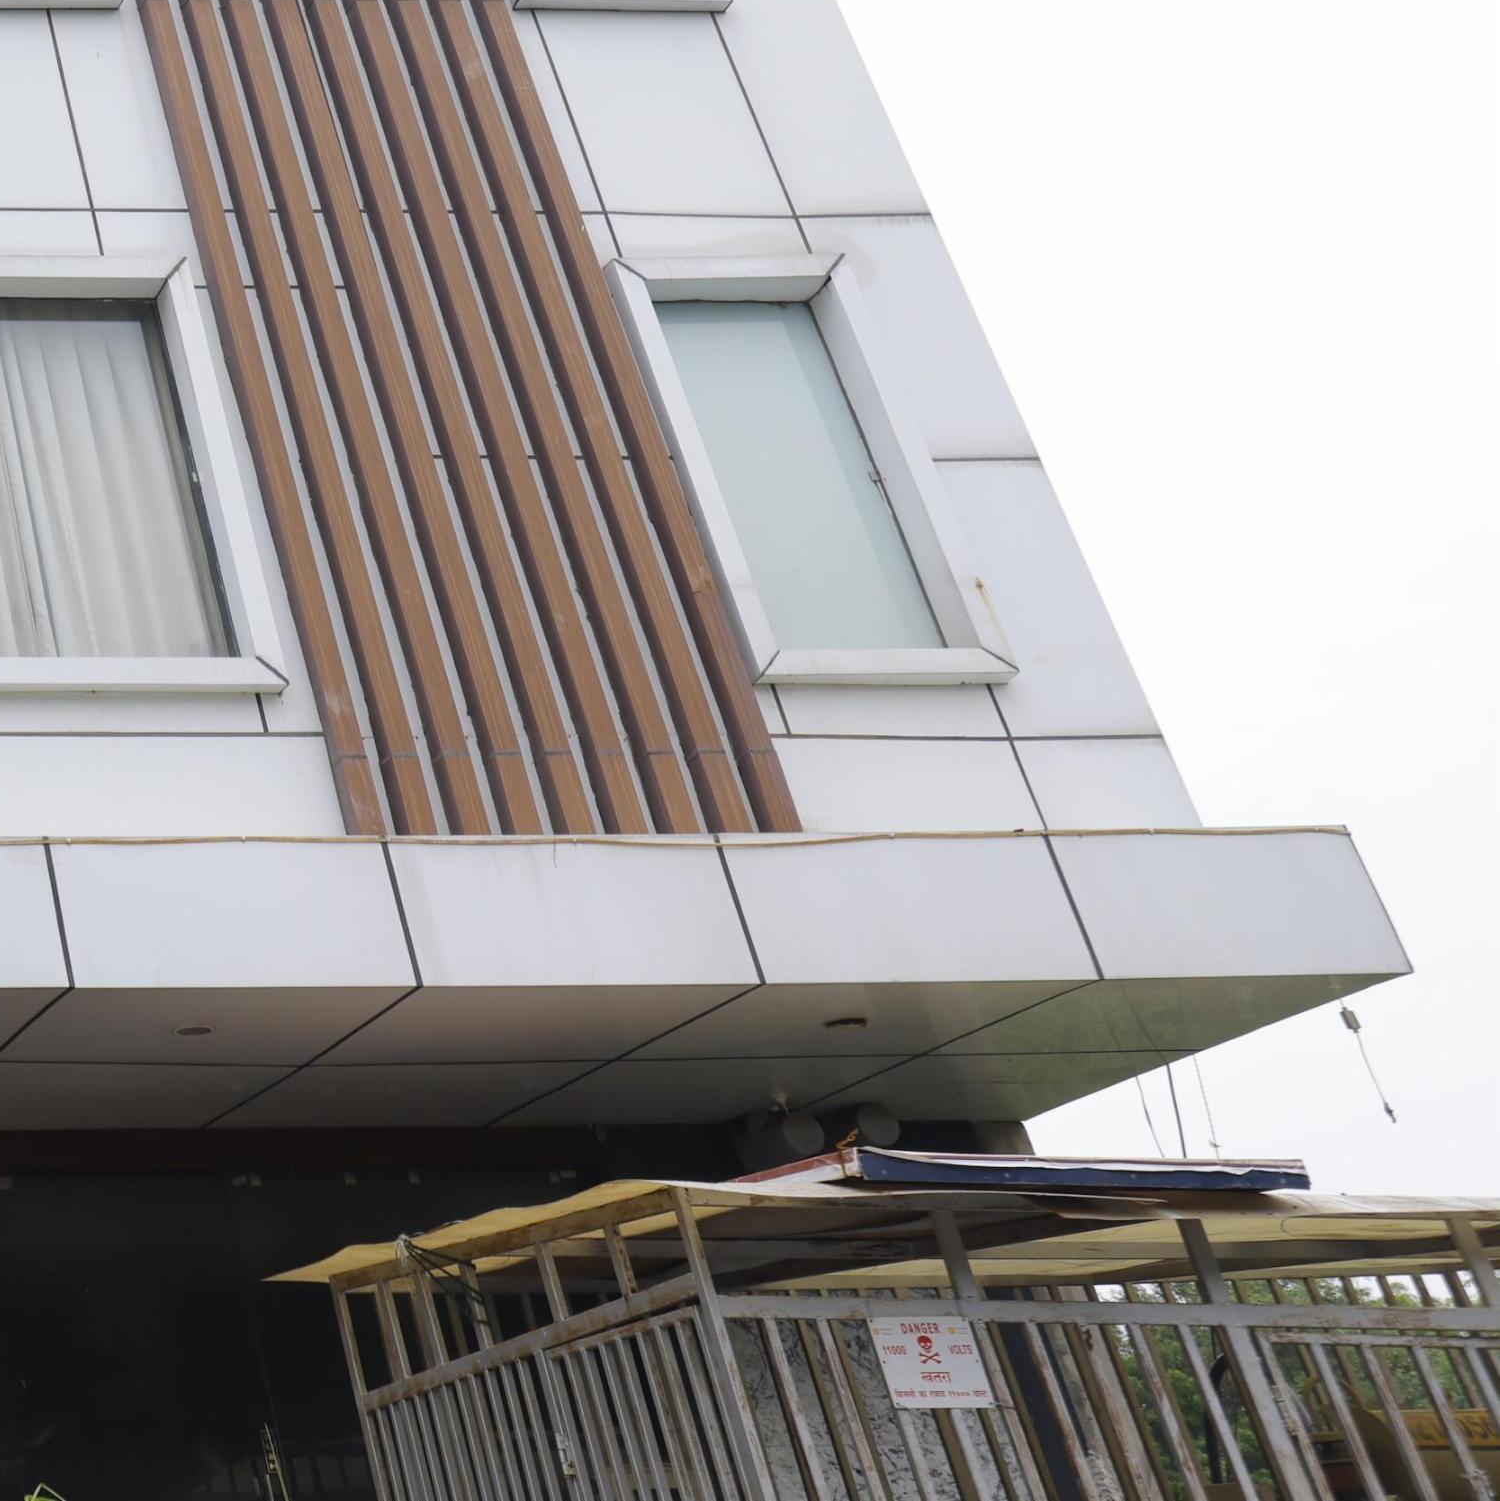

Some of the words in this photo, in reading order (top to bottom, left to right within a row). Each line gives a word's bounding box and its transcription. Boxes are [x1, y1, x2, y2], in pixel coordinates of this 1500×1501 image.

[900, 1322, 941, 1334] DANGER
[882, 1345, 907, 1356] 11000
[947, 1344, 974, 1355] VOLTS
[920, 1371, 952, 1383] खतरा
